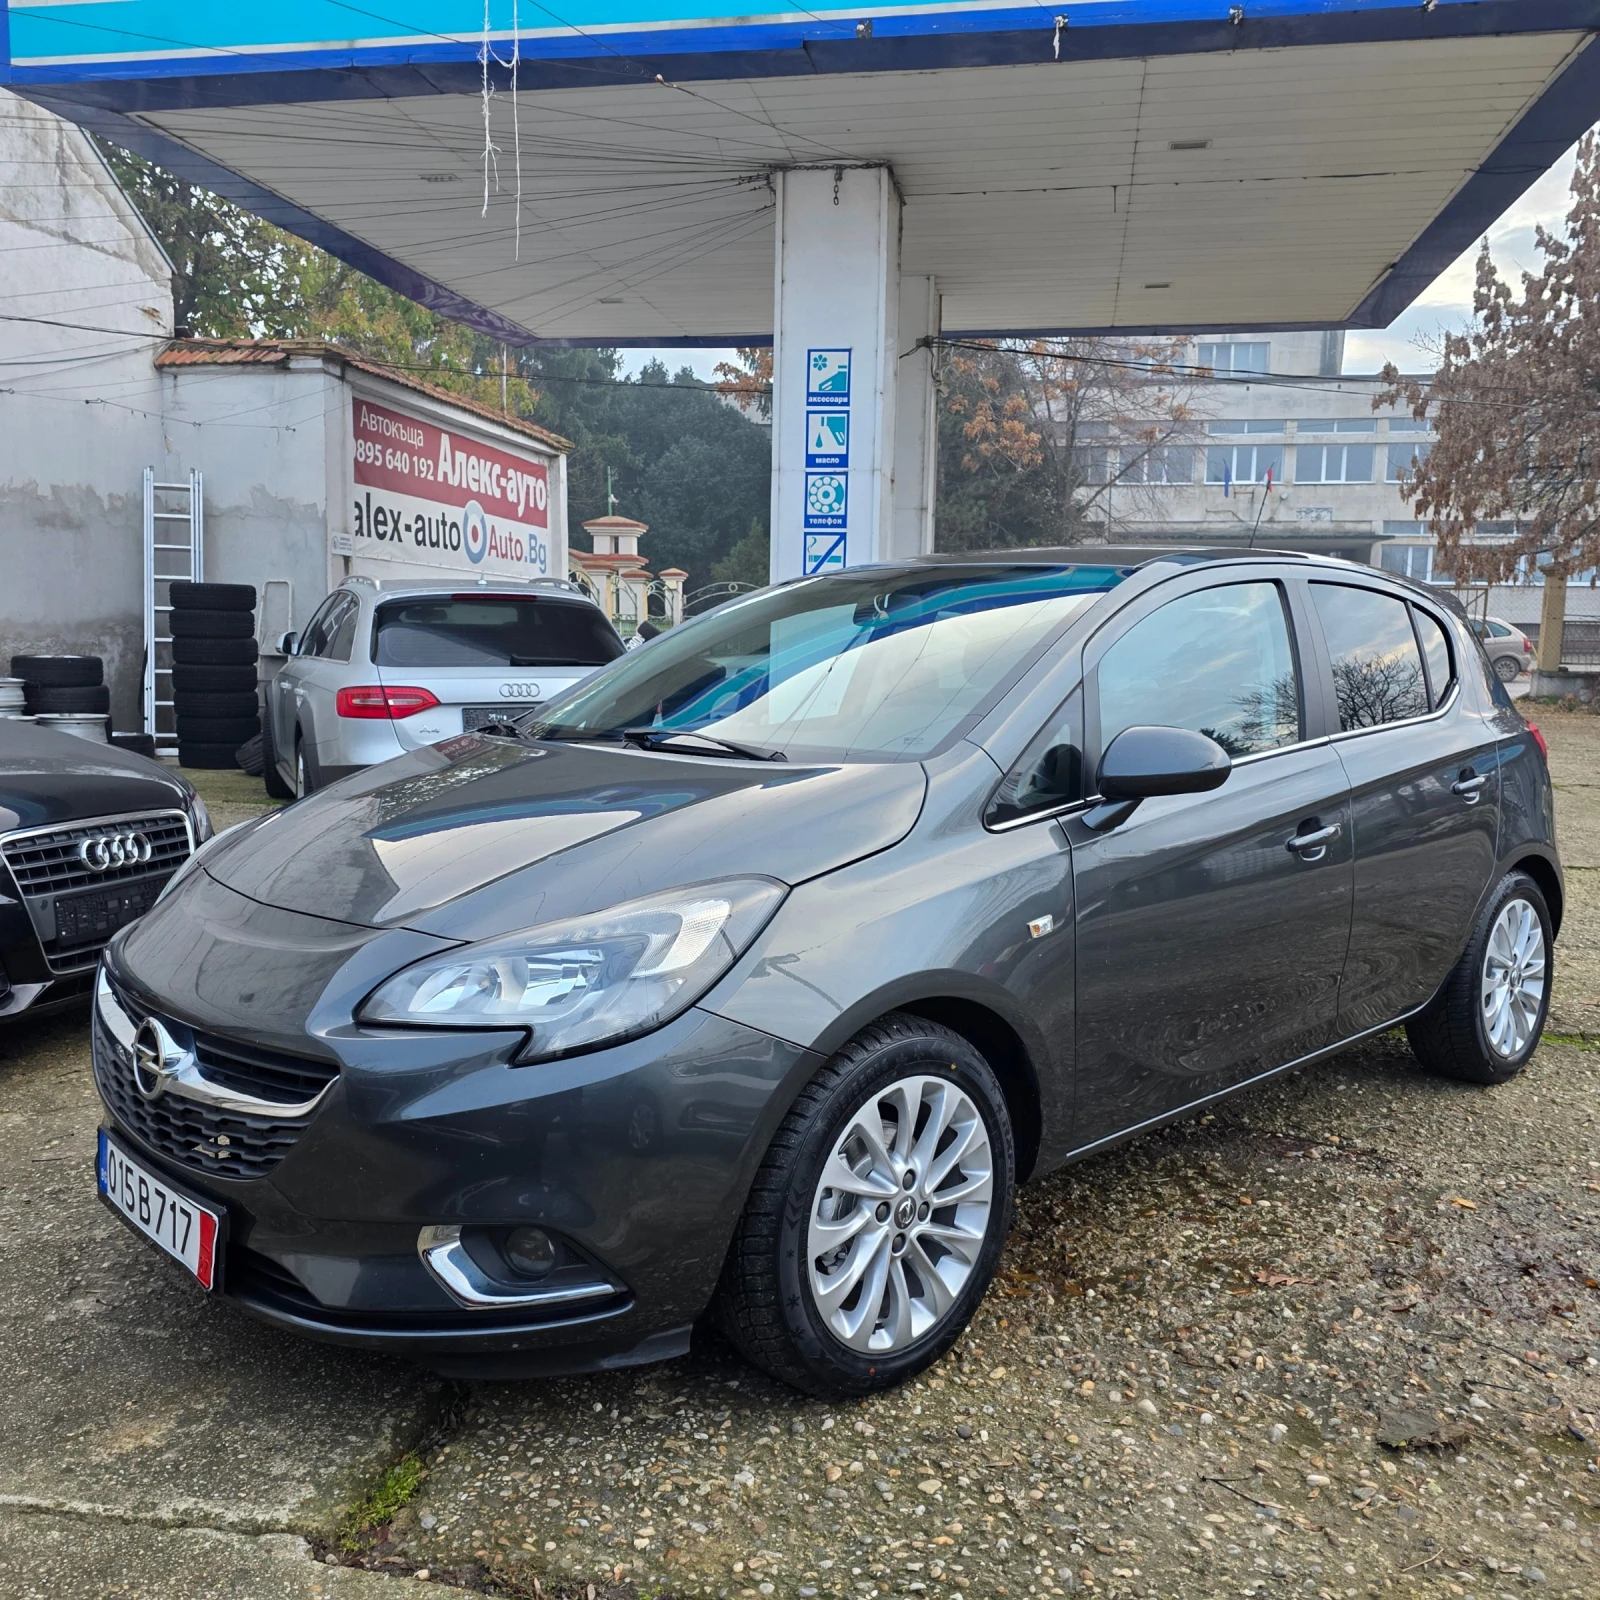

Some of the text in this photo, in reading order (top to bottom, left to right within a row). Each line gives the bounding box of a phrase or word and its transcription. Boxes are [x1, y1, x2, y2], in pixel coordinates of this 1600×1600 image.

[360, 405, 424, 450] Автокъща
[385, 448, 410, 474] 640
[412, 455, 435, 481] 192
[437, 433, 547, 518] Алекс-ауто
[354, 492, 461, 551] alex-auto
[809, 517, 843, 526] телефон
